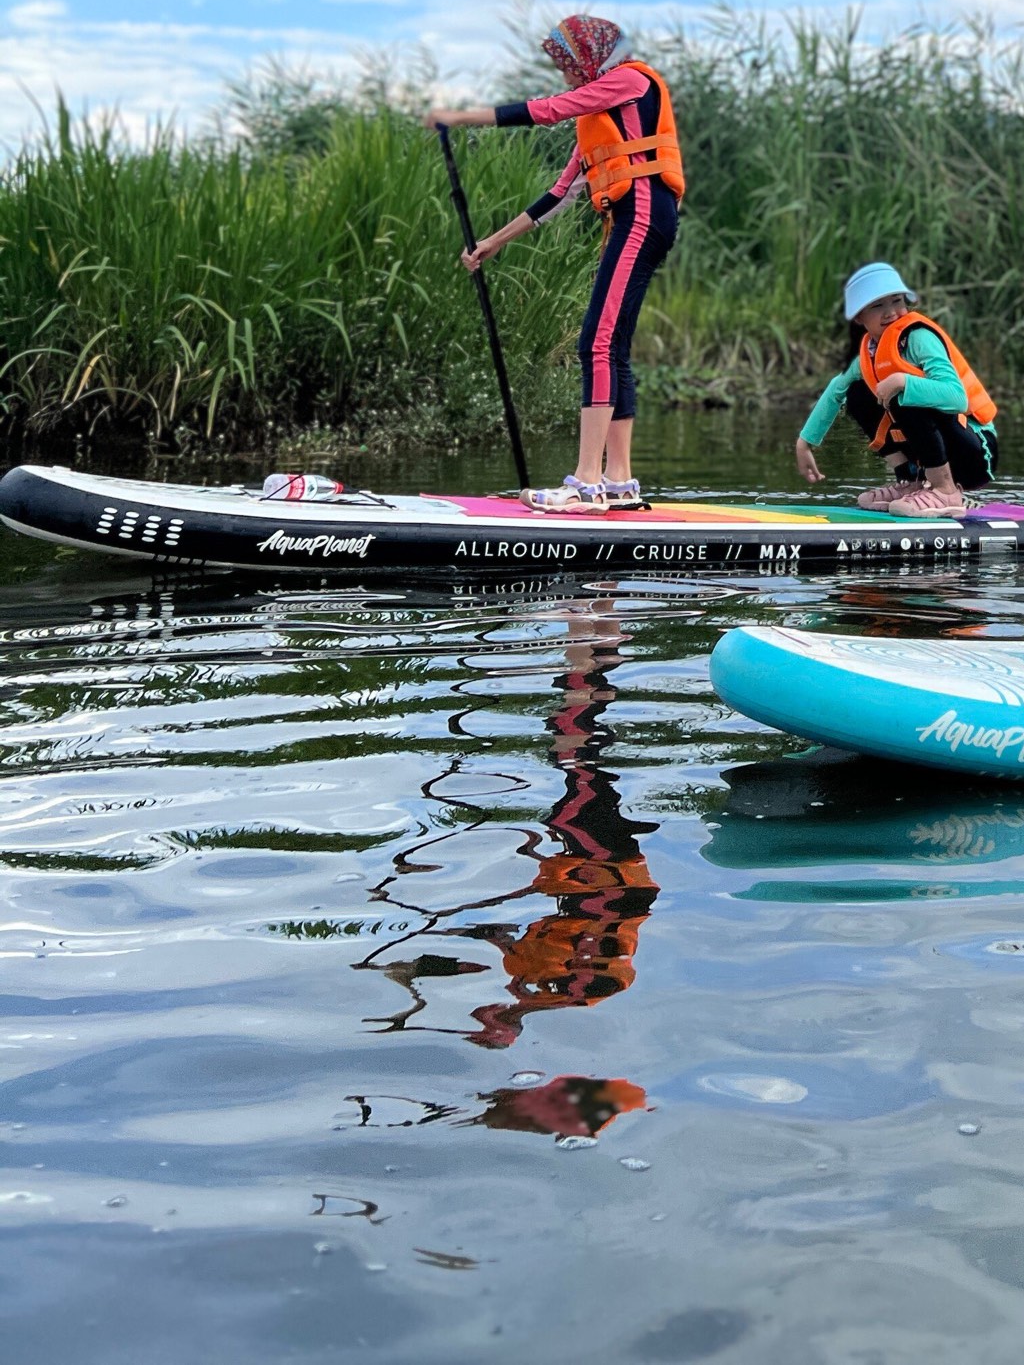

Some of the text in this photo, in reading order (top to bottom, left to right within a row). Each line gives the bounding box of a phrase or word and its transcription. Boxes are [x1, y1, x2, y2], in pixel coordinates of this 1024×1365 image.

[257, 529, 377, 558] AquaPlanet
[455, 540, 577, 559] ALLROUND
[632, 544, 708, 560] CRUISE
[759, 544, 802, 560] MAX
